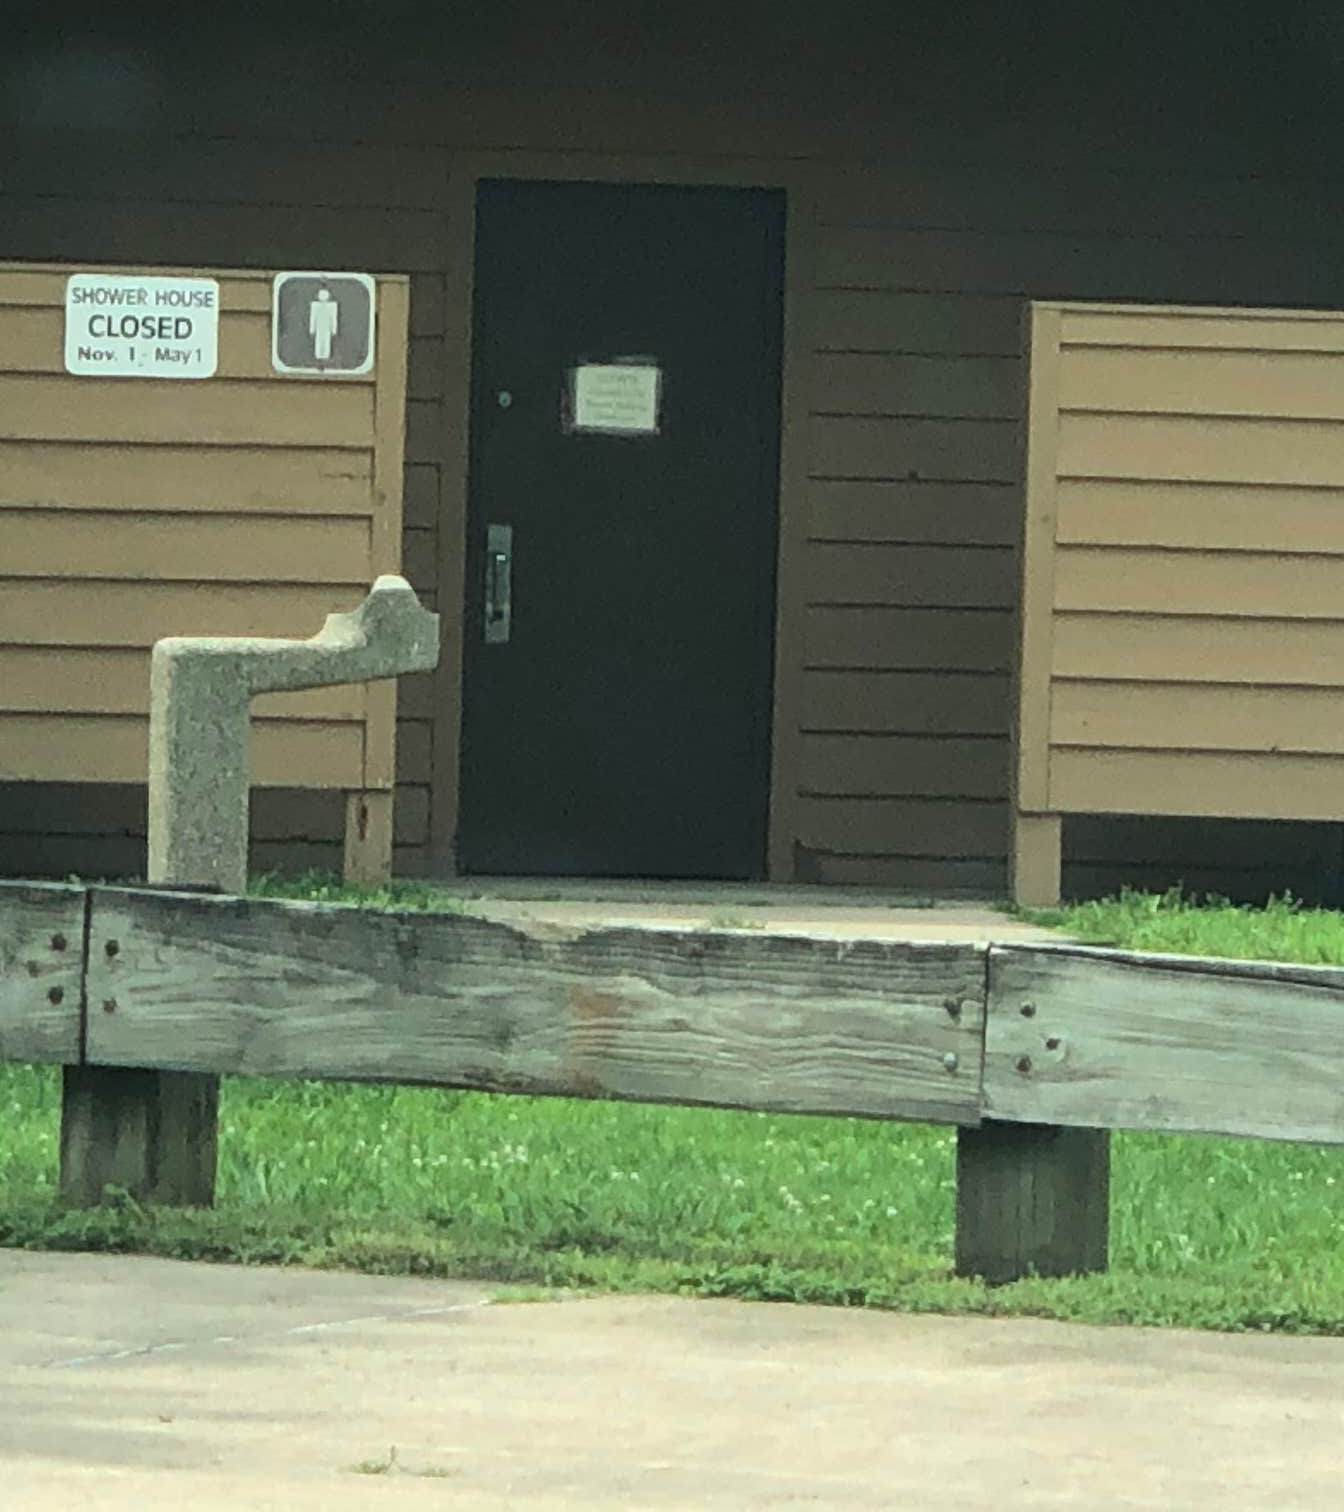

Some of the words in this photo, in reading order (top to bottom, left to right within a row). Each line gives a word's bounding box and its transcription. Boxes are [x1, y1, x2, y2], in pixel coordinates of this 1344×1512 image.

[71, 287, 148, 305] SHOWER
[155, 290, 214, 307] HOUSE
[88, 314, 193, 339] CLOSED
[77, 346, 117, 361] Nov.
[155, 348, 191, 364] May
